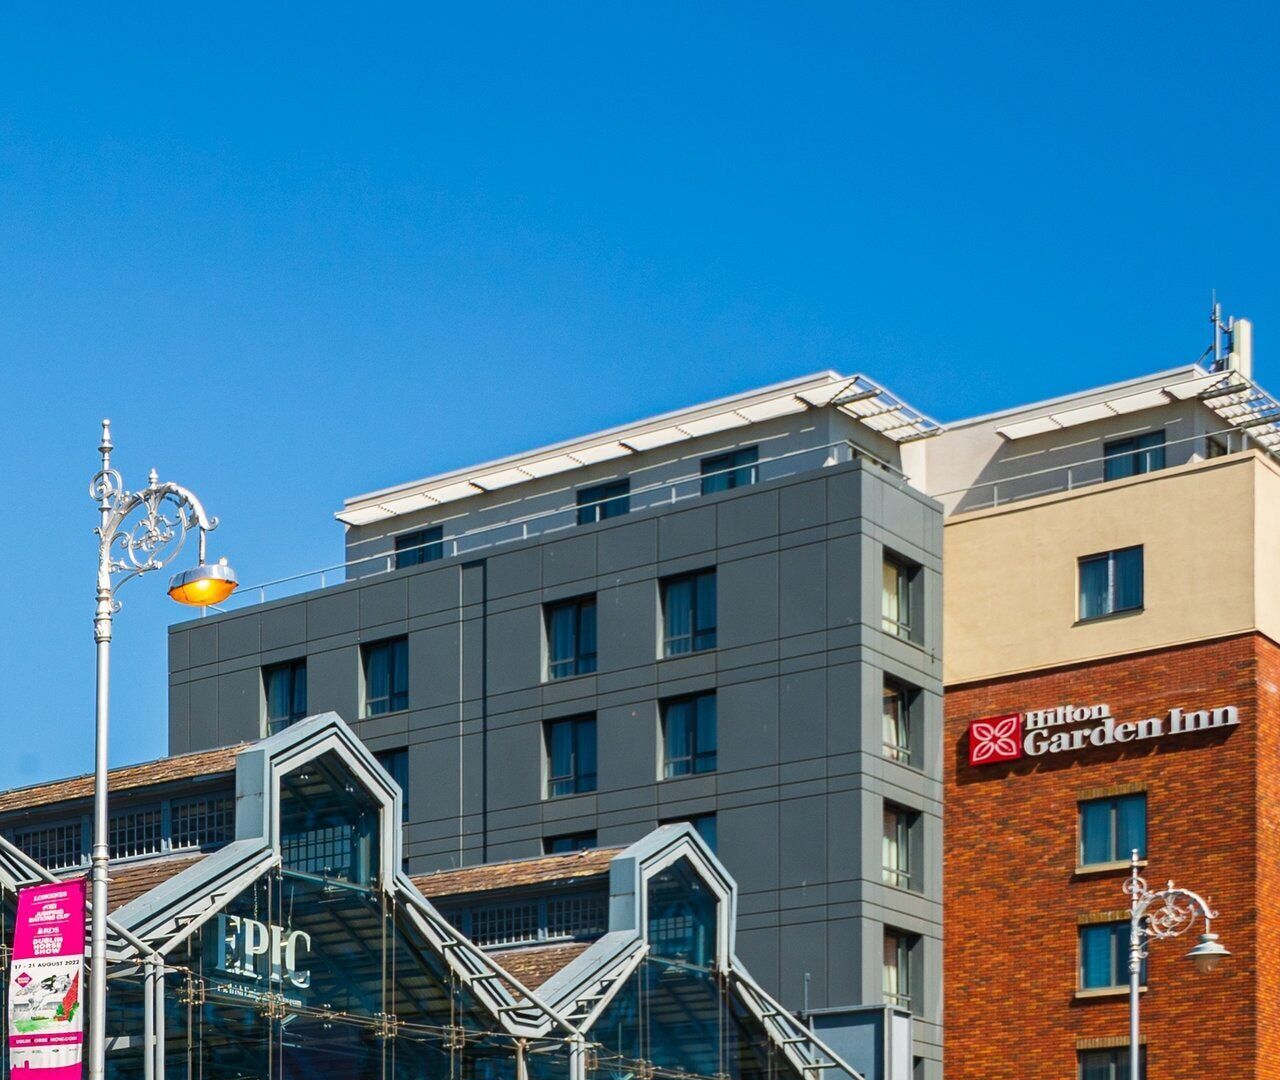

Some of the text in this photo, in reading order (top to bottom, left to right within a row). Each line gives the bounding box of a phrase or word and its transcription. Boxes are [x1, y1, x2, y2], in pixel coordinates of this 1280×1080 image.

[1024, 703, 1111, 730] Hilton
[1024, 705, 1241, 756] Garden Inn
[32, 937, 63, 945] DUBLIN
[216, 913, 311, 989] EPIC
